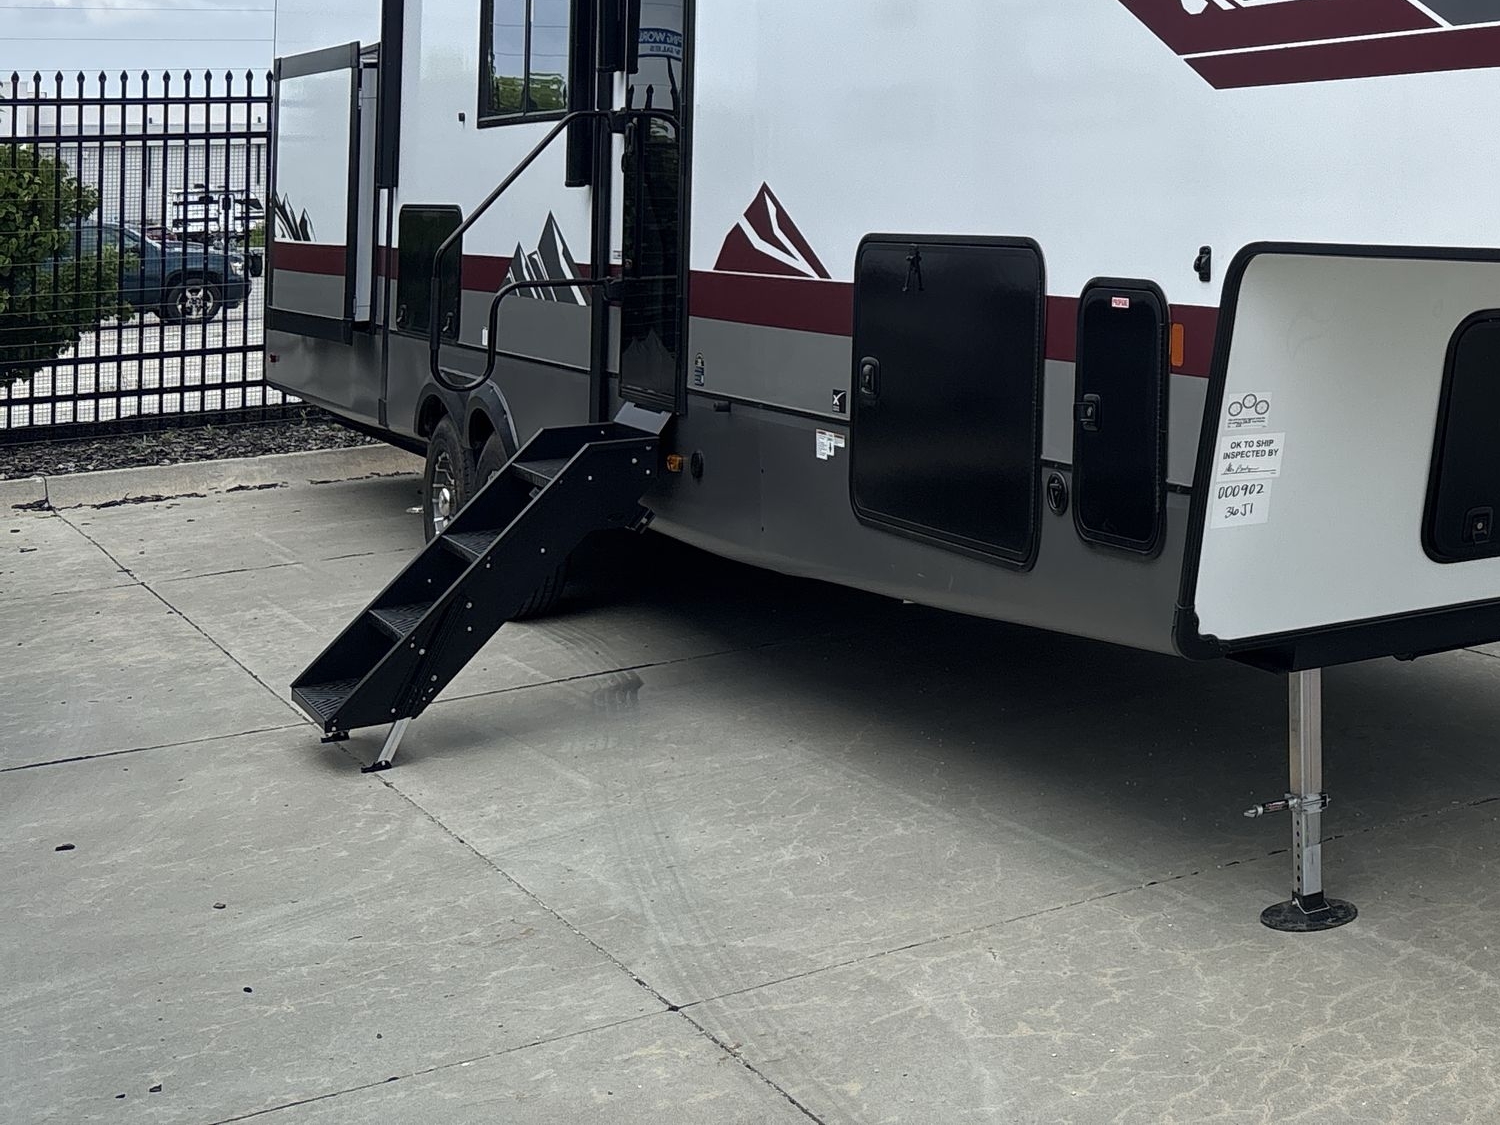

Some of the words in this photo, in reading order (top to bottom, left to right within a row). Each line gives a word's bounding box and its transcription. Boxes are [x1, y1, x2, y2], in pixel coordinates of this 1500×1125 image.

[1230, 441, 1242, 449] OK
[1244, 440, 1254, 448] TO
[1256, 439, 1274, 448] SHIP
[1223, 449, 1267, 460] INSPECTED
[1267, 448, 1279, 457] BY
[1218, 483, 1264, 499] 000902
